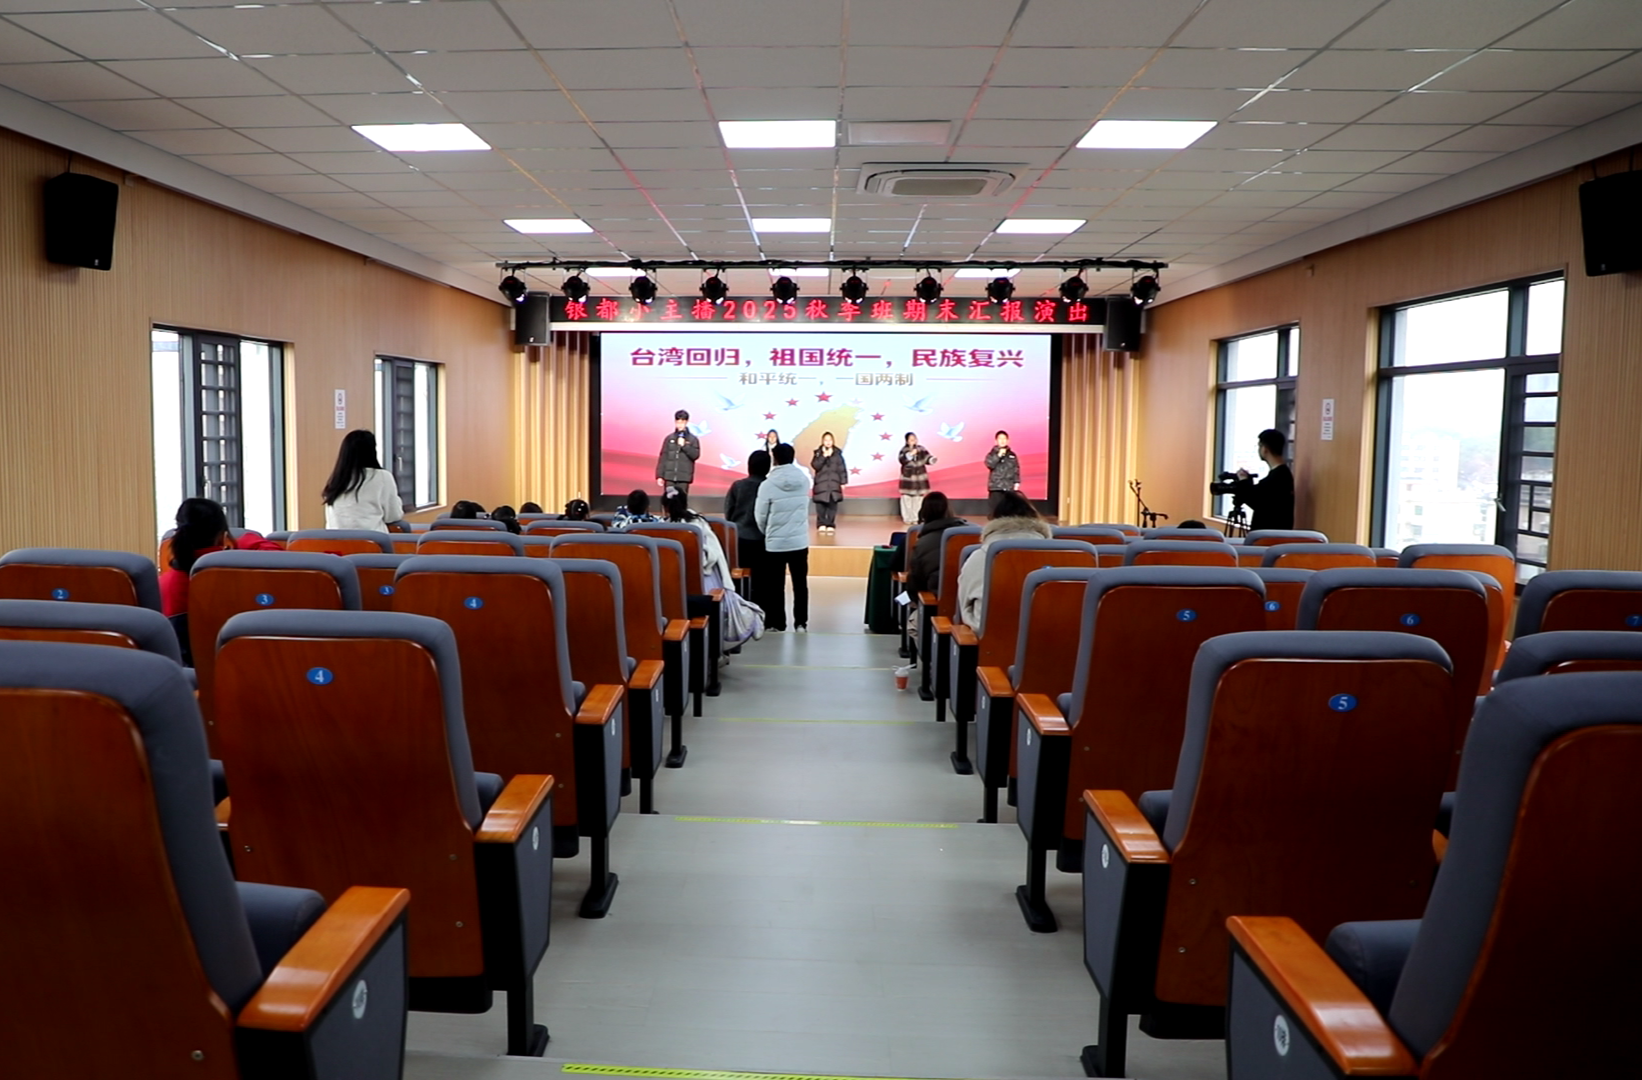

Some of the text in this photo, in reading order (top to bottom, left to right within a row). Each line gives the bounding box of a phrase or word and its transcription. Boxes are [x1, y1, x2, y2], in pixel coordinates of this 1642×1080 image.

[630, 347, 1024, 368] 台湾回归，祖国统一，民族复兴
[314, 669, 325, 683] 4
[1338, 696, 1348, 710] 5
